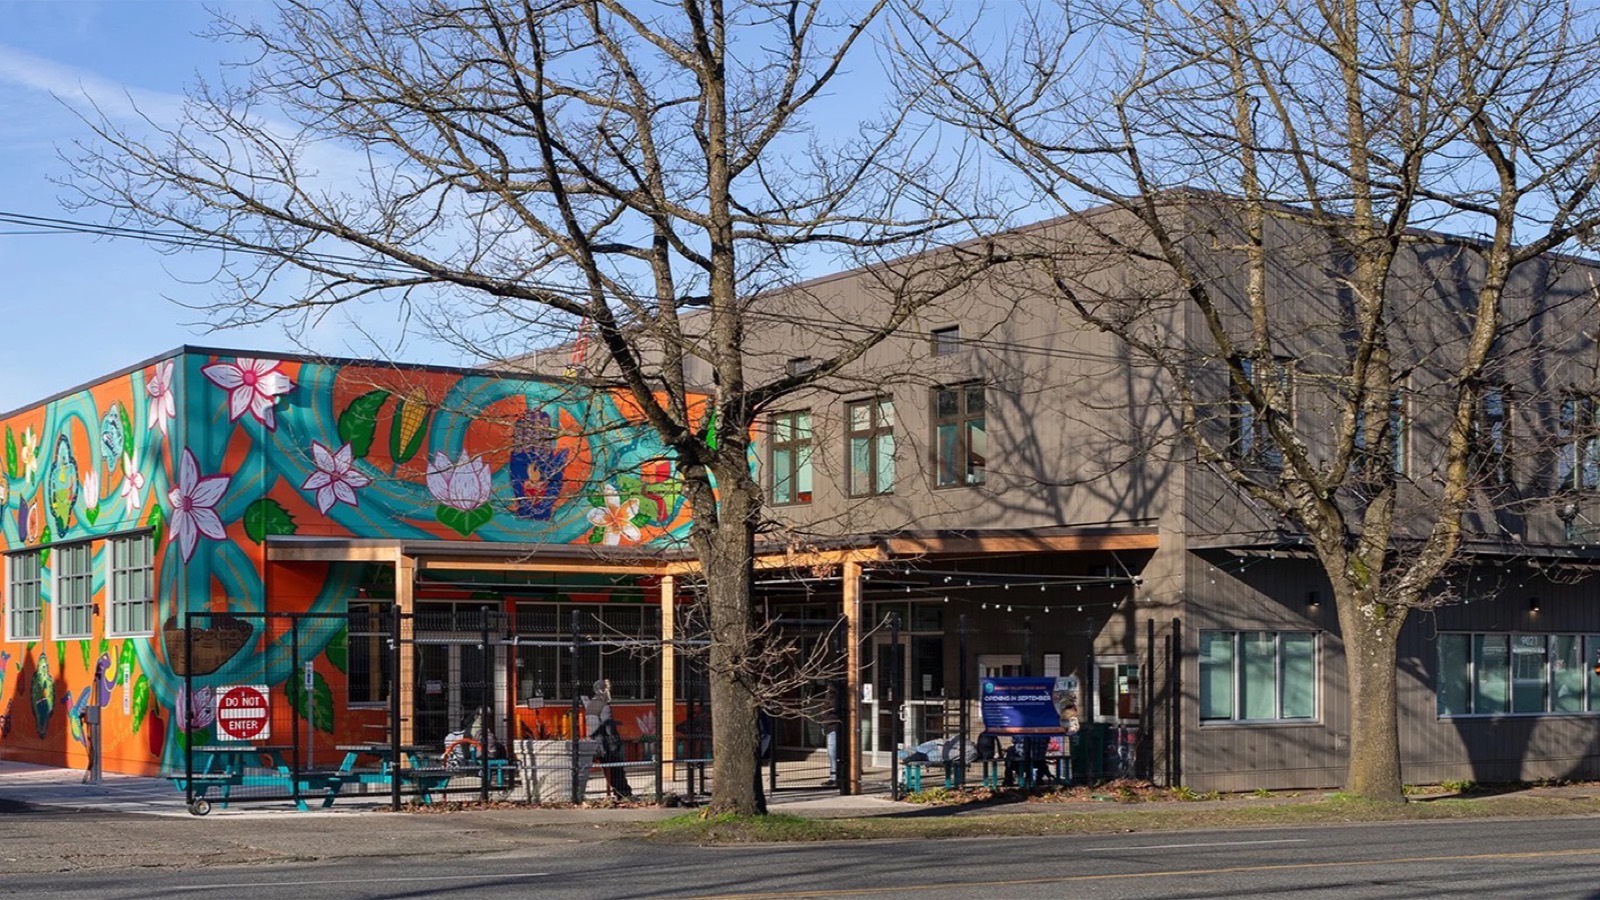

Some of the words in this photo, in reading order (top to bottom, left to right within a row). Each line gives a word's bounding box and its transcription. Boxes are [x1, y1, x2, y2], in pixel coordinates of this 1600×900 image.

[225, 697, 239, 706] DO
[242, 697, 260, 706] NOT
[229, 720, 258, 730] ENTER
